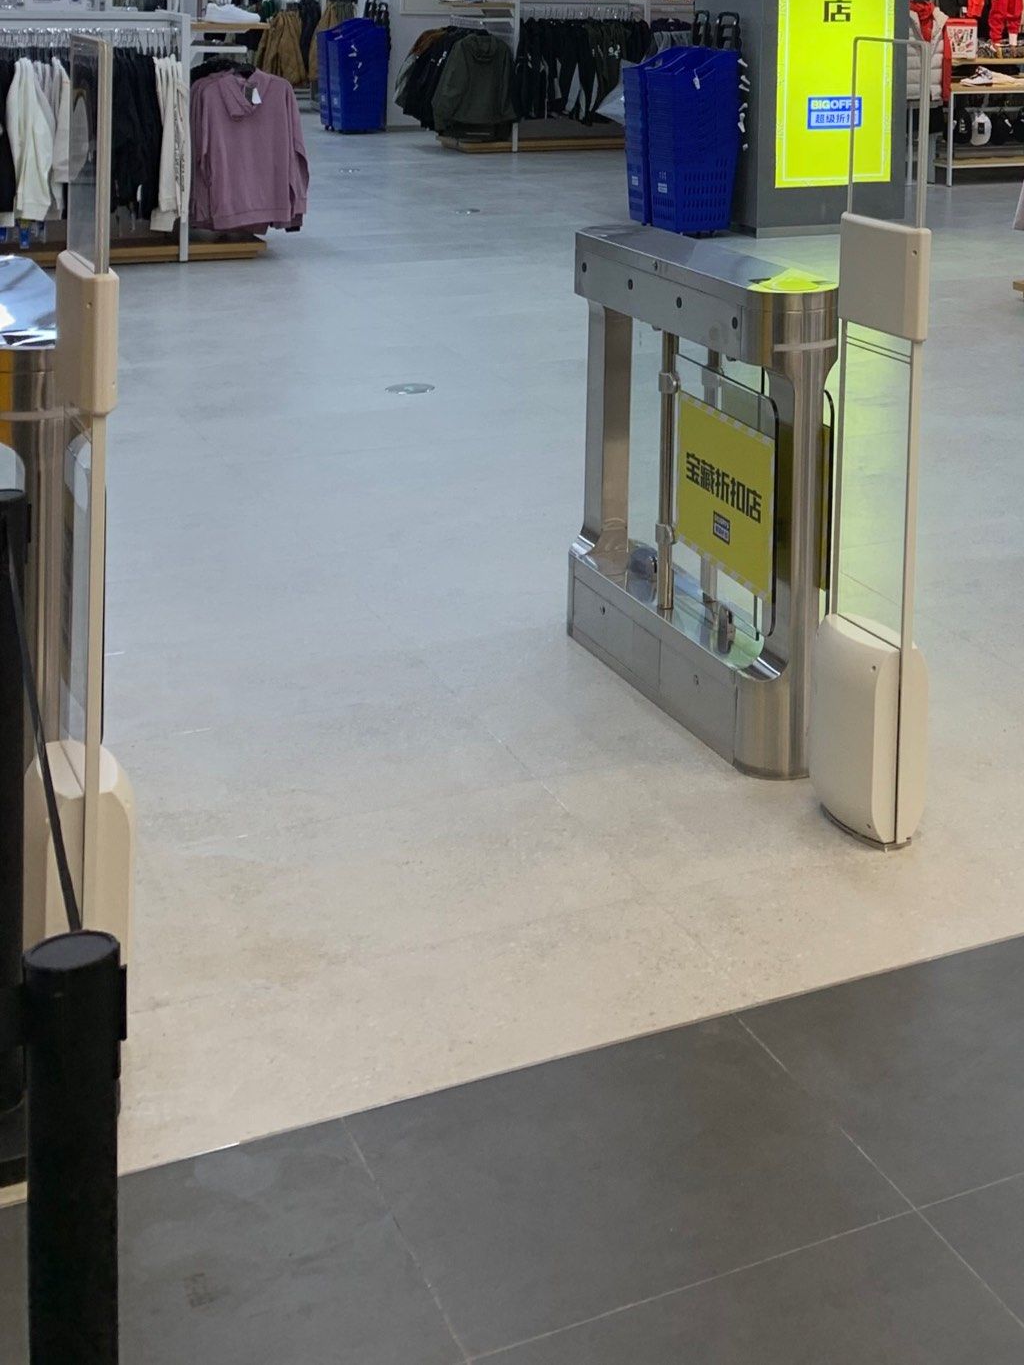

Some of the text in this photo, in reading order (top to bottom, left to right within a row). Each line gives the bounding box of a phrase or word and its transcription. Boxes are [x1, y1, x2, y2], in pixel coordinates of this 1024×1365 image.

[815, 113, 851, 124] 超级折
[685, 452, 763, 524] 宝藏折扣店
